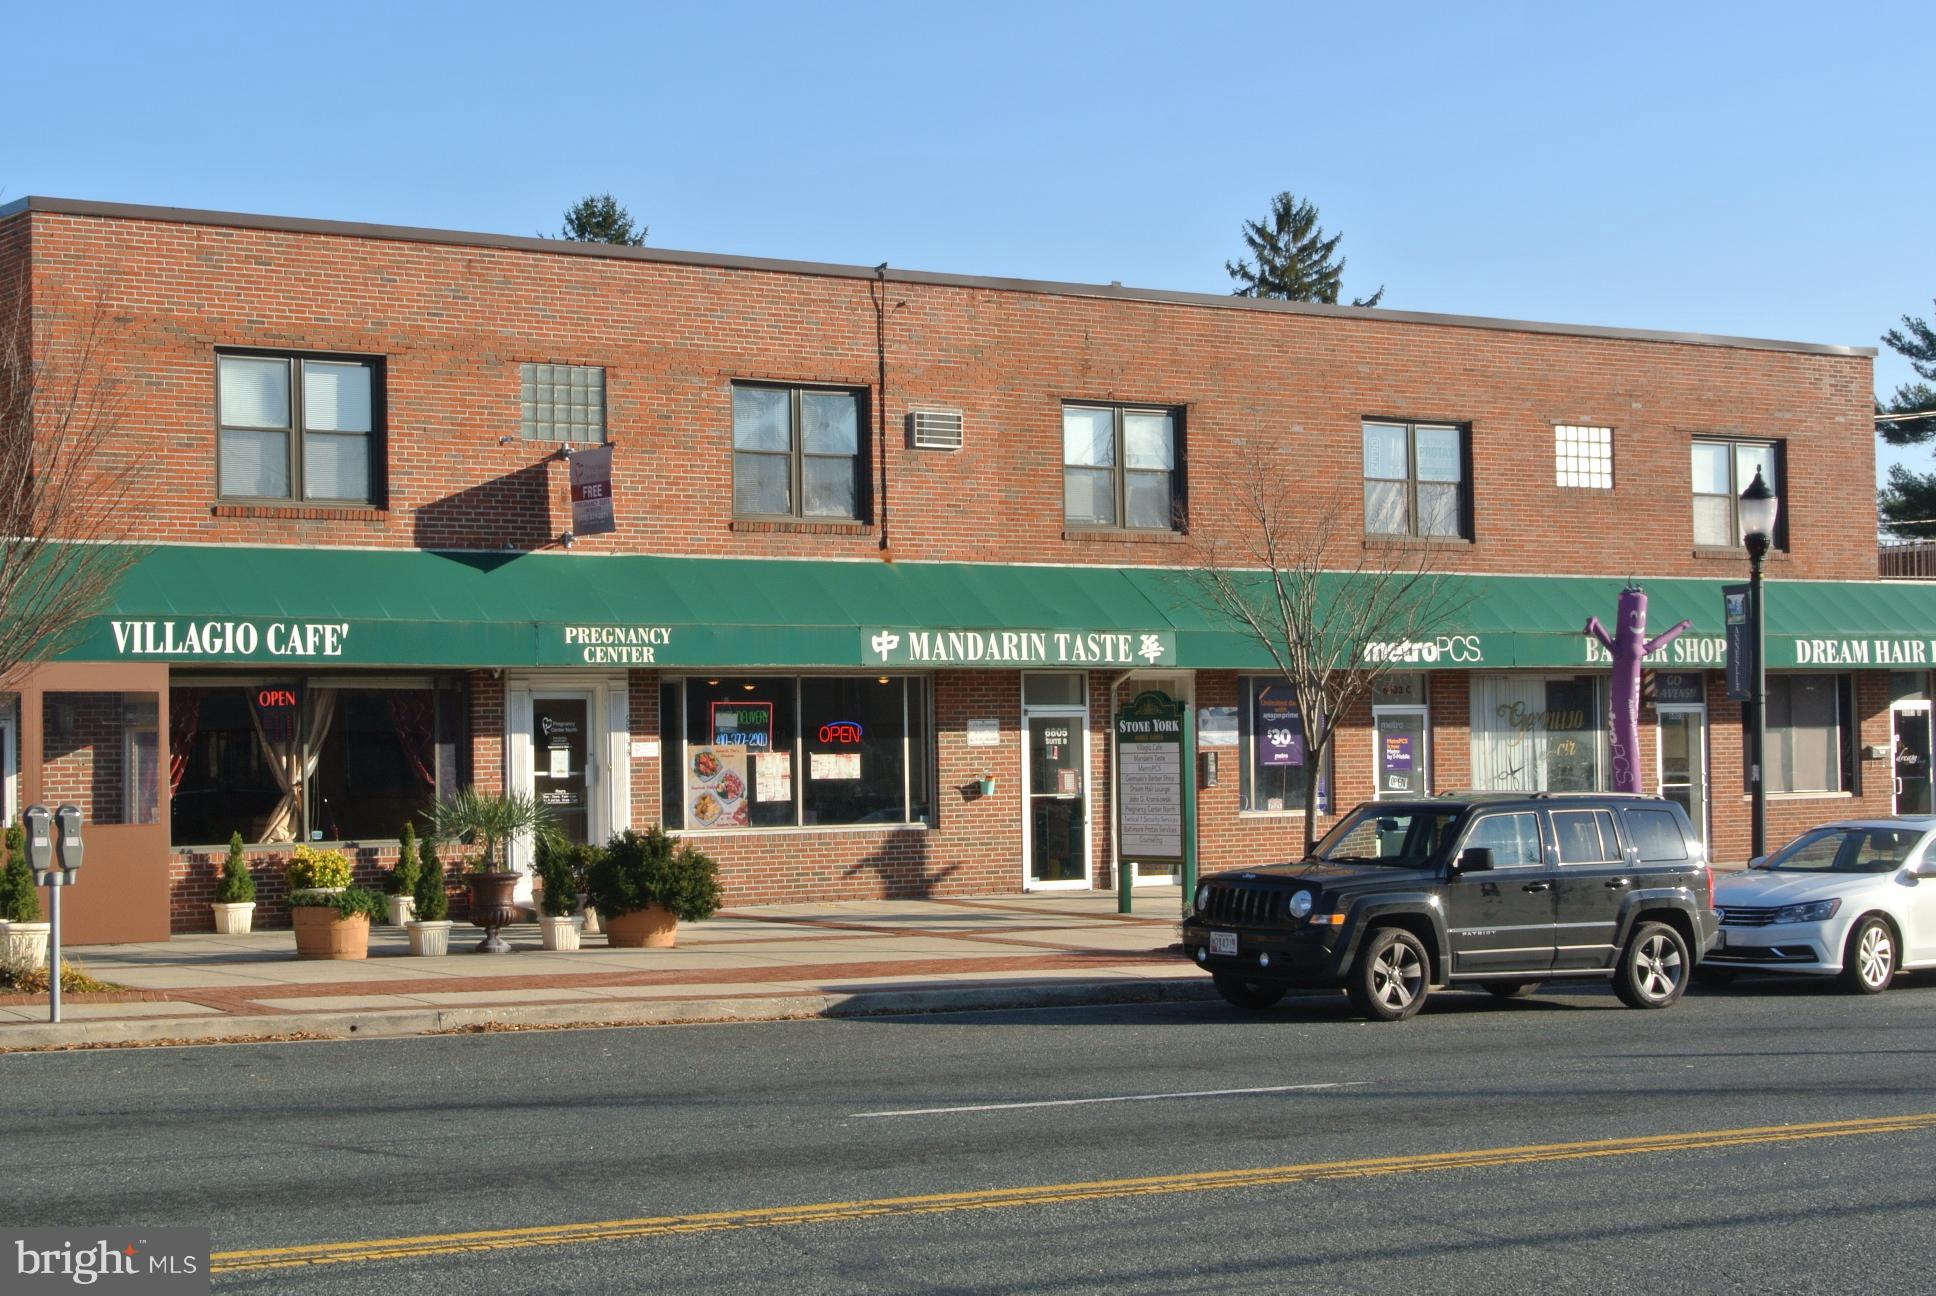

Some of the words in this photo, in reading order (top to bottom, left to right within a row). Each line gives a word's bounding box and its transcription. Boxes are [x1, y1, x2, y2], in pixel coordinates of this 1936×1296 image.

[583, 485, 603, 499] FREE
[111, 621, 258, 654] VILLAGIO
[565, 627, 672, 644] PREGNANCY
[583, 646, 655, 662] CENTER
[872, 630, 900, 662] 中
[908, 632, 1046, 661] MANDARIN
[1054, 634, 1132, 662] TASTE
[1585, 637, 1668, 662] BAER
[1674, 638, 1728, 662] SHOP
[1795, 640, 1869, 664] DREAM
[1874, 640, 1926, 664] HAIR
[1666, 676, 1682, 686] GO
[259, 690, 296, 707] OPEN
[737, 710, 768, 725] DELIVERY
[1120, 720, 1150, 733] STONE
[1152, 718, 1179, 732] YORK
[820, 726, 860, 743] OPEN
[1267, 728, 1292, 746] $30
[1391, 776, 1407, 788] OPEN
